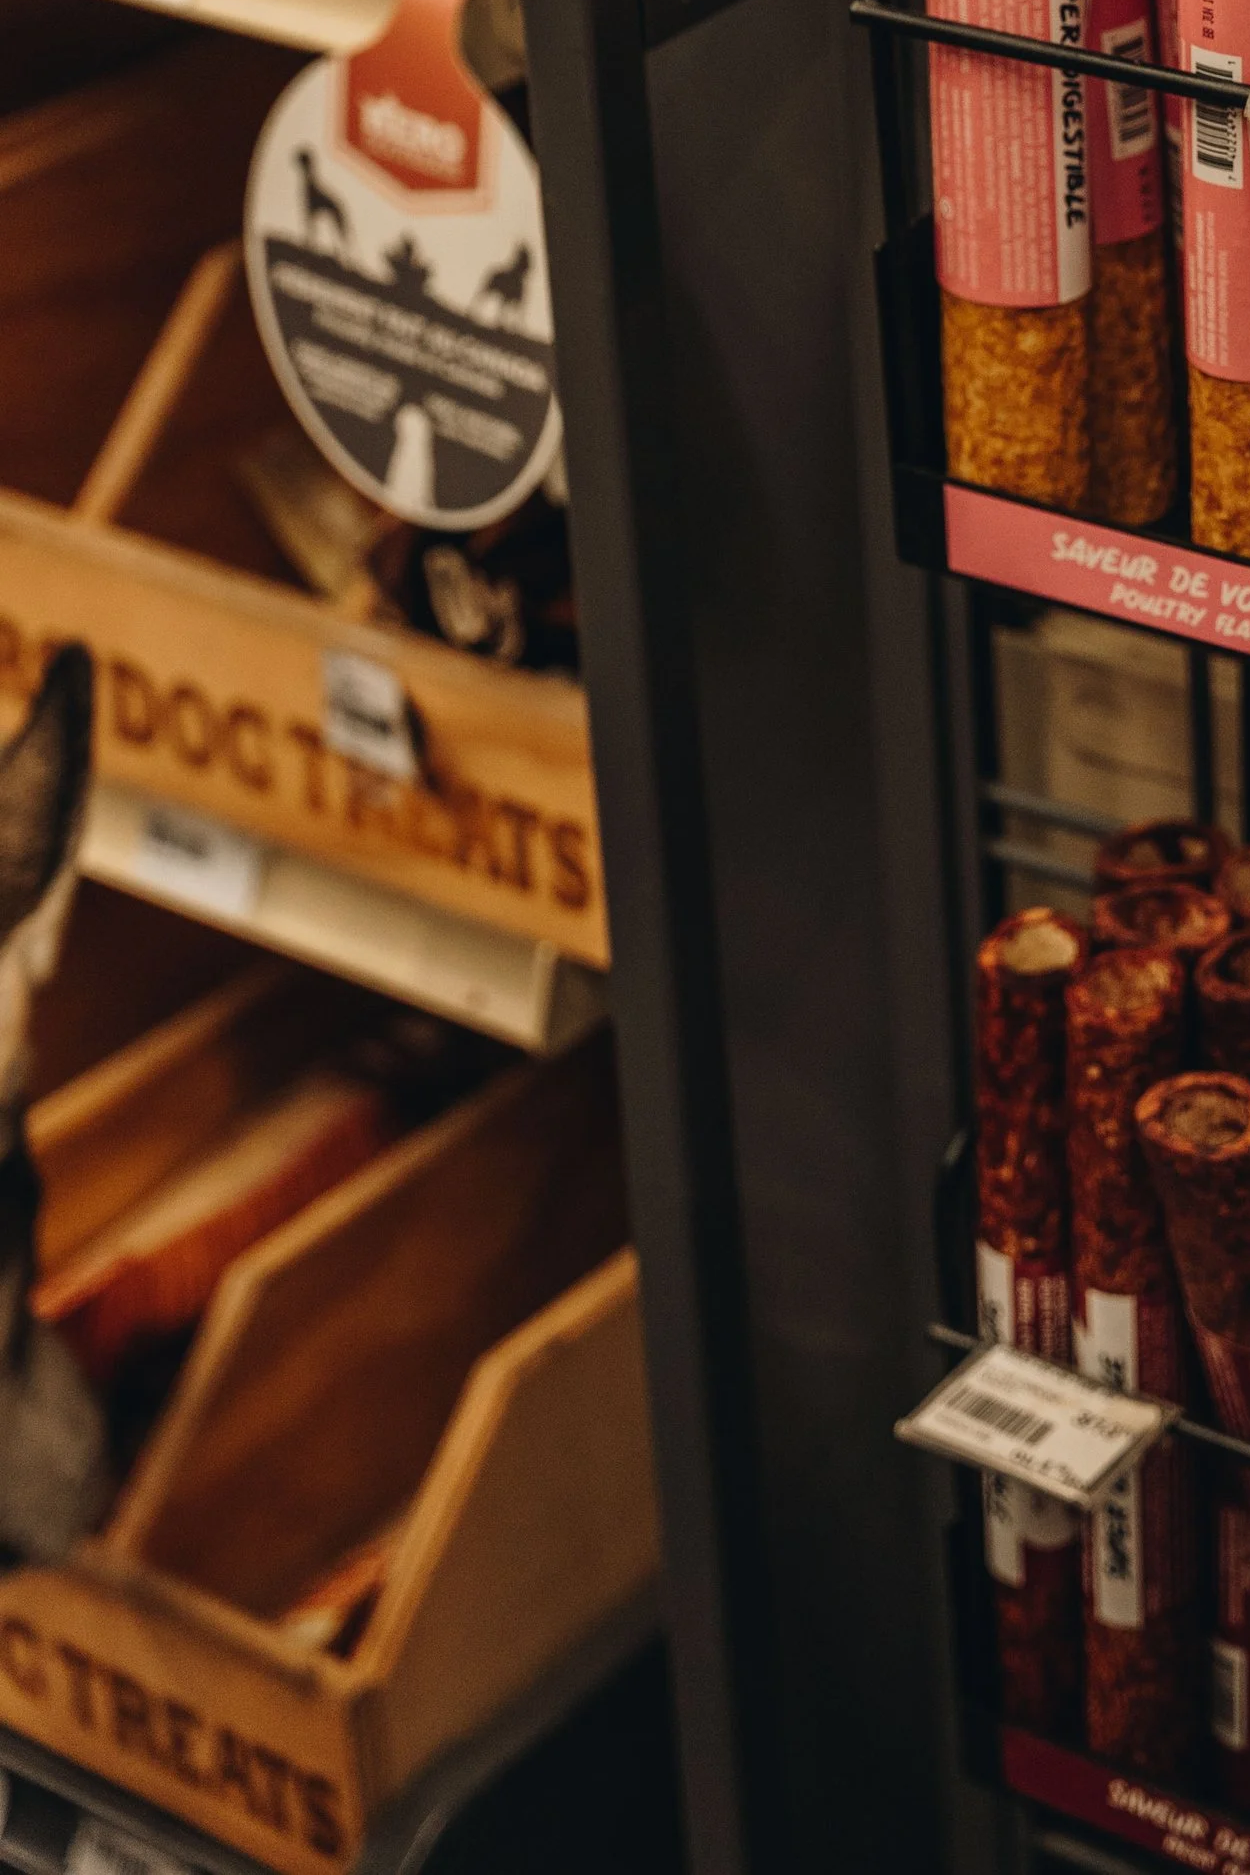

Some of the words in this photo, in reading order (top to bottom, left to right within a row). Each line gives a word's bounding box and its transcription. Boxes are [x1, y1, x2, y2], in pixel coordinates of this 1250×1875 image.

[1051, 531, 1161, 587] SAVEUR
[1169, 564, 1210, 600] DE
[1109, 583, 1207, 629] POULTRY
[110, 658, 274, 797] DOG
